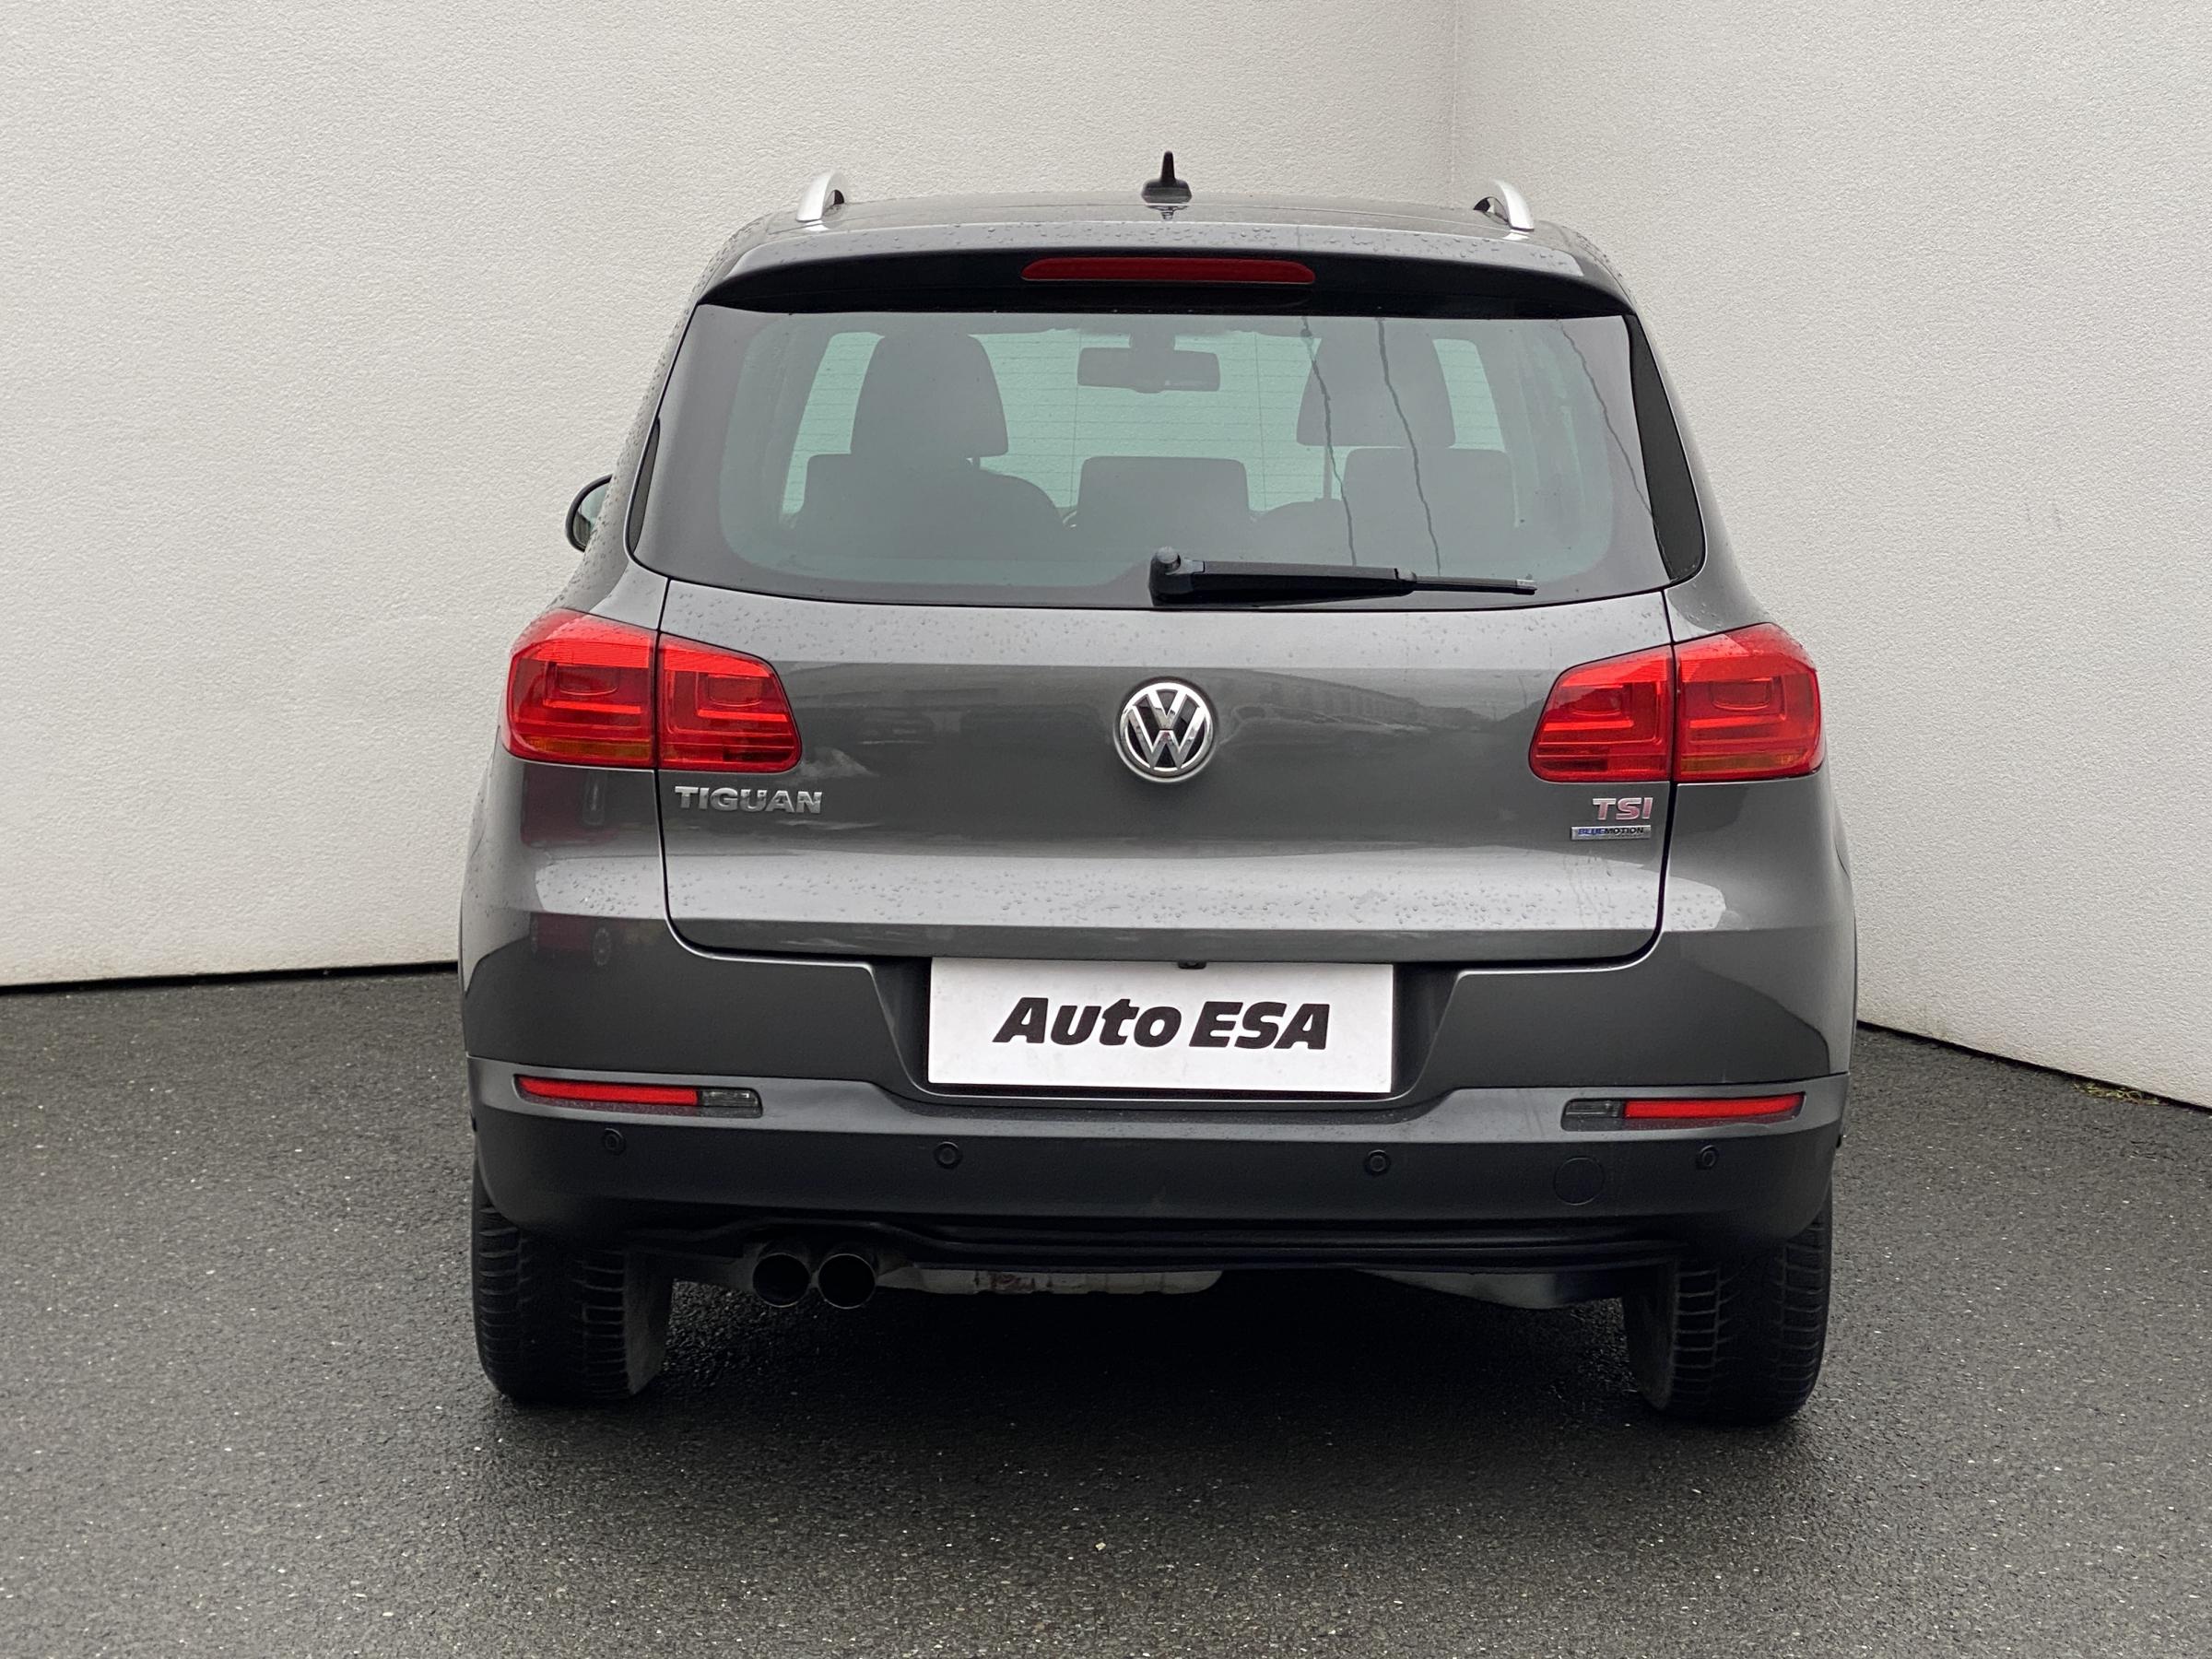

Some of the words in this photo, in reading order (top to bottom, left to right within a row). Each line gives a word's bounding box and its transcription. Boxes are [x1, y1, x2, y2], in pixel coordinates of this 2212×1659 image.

[674, 785, 823, 814] TIGUAN
[1592, 796, 1653, 820] TSI
[992, 996, 1182, 1048] Auto
[1188, 1001, 1331, 1051] ESA
